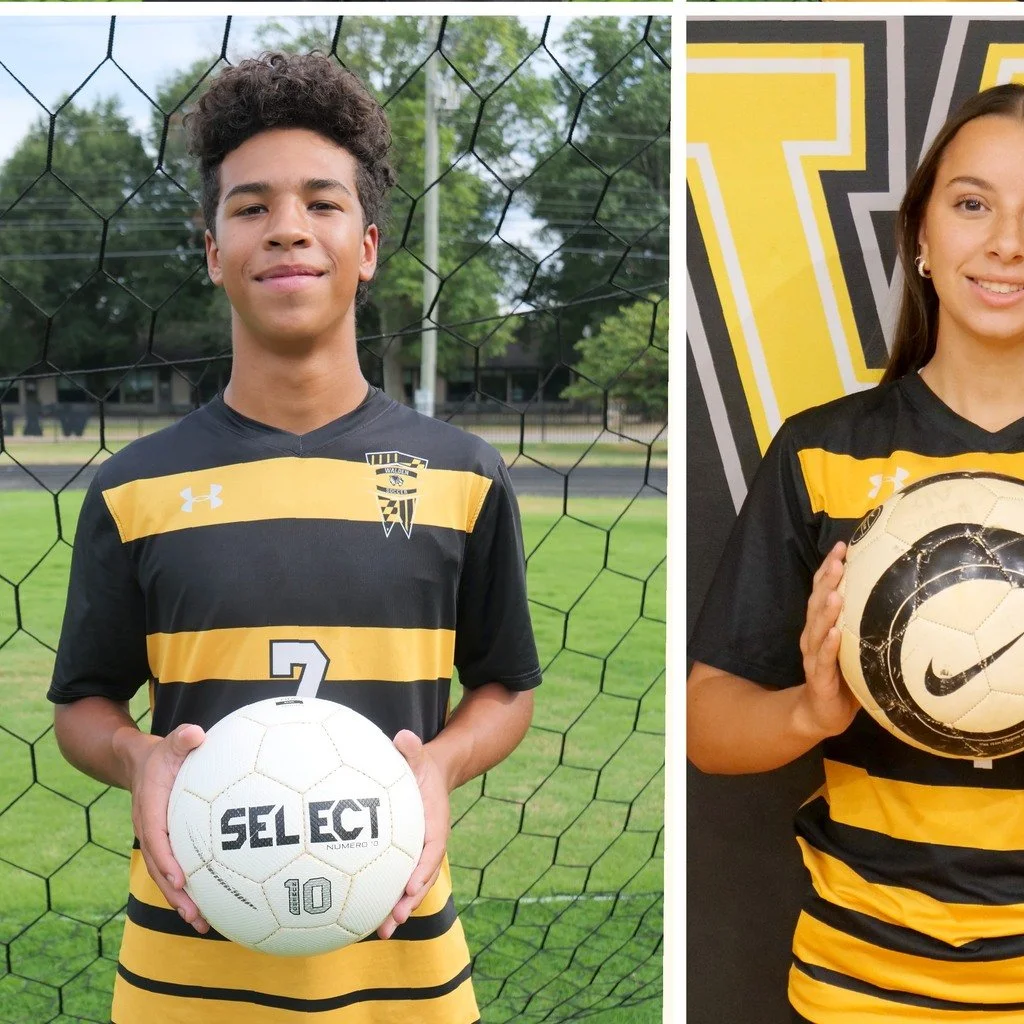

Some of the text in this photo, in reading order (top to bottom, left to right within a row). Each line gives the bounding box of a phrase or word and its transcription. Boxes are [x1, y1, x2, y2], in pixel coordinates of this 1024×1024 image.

[384, 467, 410, 476] WALDEN
[269, 639, 331, 699] 7
[220, 797, 381, 851] SELECT
[326, 841, 368, 851] NUMERO
[284, 876, 333, 916] 10
